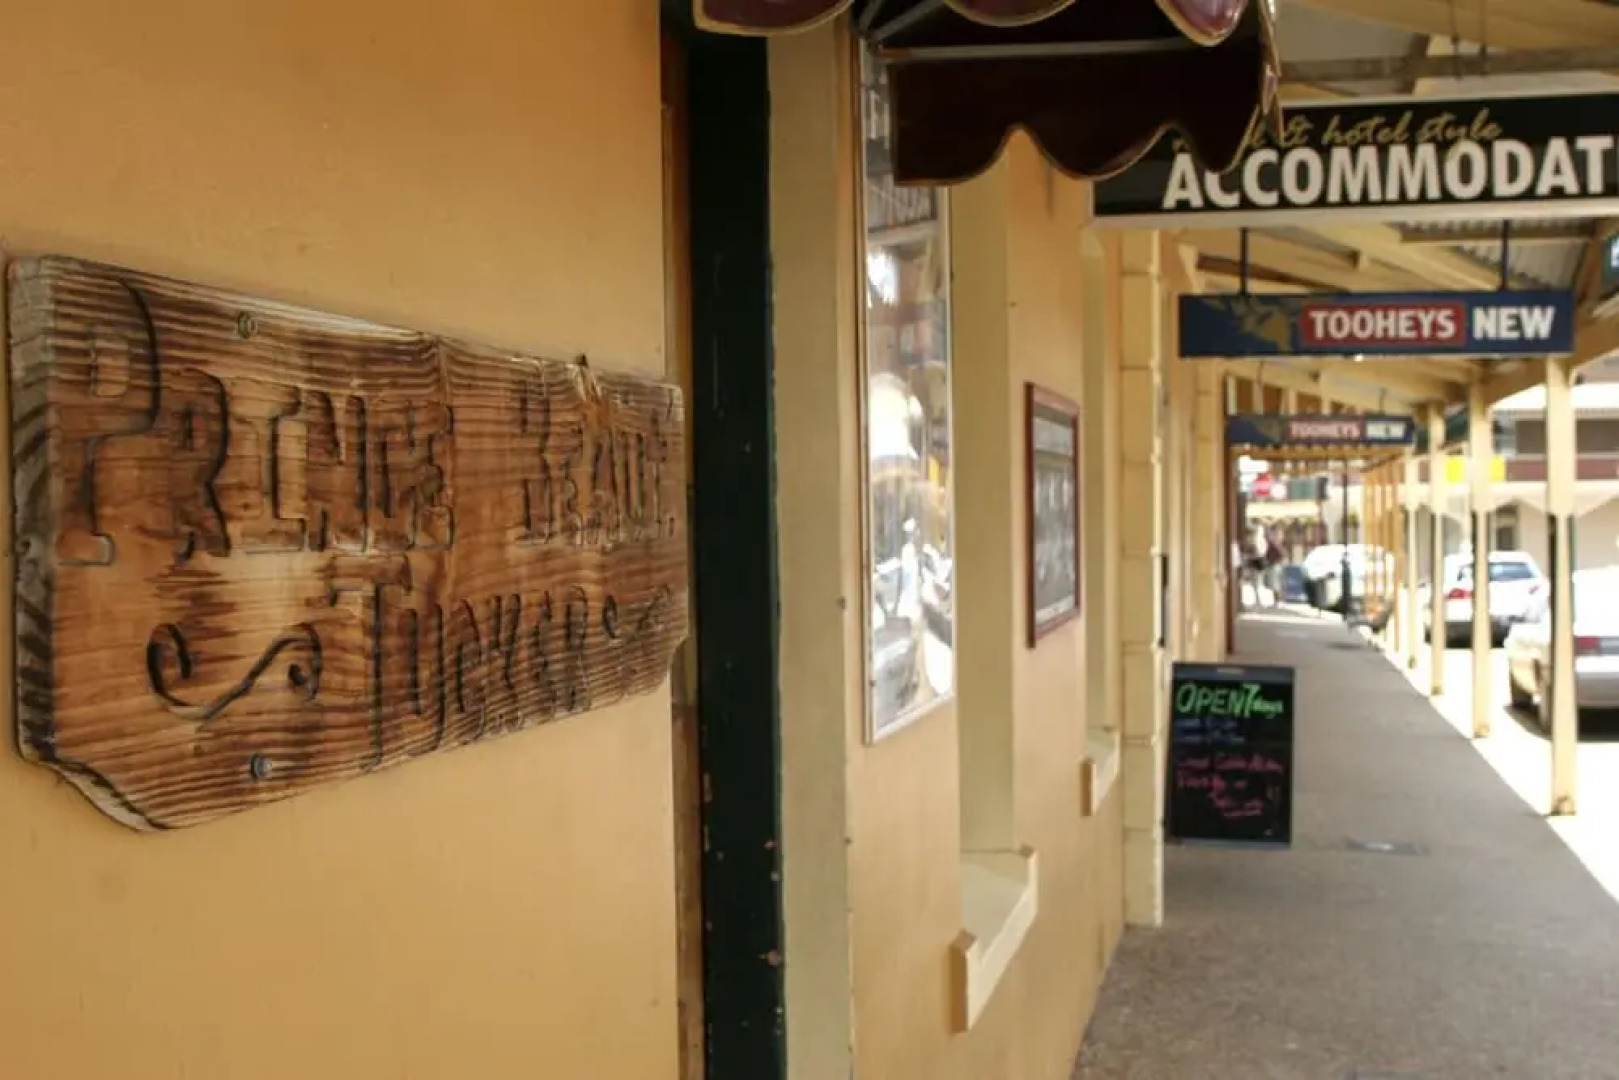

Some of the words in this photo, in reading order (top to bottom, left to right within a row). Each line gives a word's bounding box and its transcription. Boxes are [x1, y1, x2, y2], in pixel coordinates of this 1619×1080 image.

[1321, 110, 1414, 145] hotel
[1416, 107, 1504, 158] style
[1162, 136, 1619, 209] ACCOMMODAT
[1307, 307, 1456, 340] TOOHEYS
[1472, 306, 1555, 340] NEW
[1176, 683, 1246, 716] OPEN
[1241, 682, 1261, 718] 7
